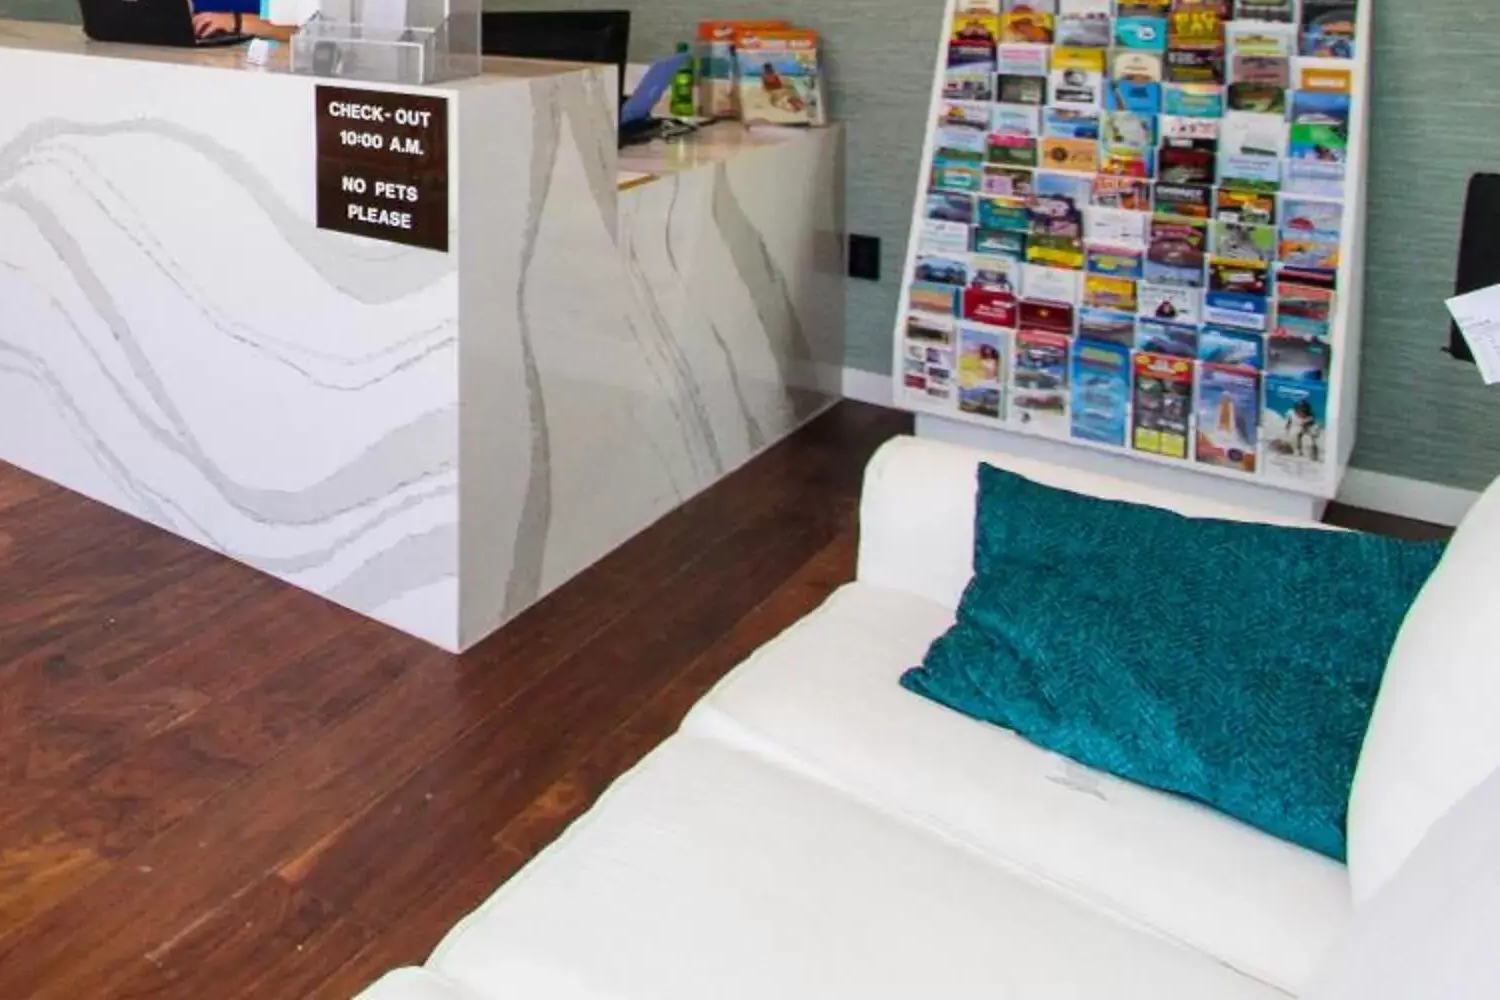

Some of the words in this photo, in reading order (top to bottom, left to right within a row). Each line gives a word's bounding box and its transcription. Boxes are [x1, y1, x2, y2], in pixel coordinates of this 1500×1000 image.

[339, 130, 383, 149] 10:00
[389, 137, 424, 155] A.M.
[342, 176, 366, 193] NO
[375, 181, 418, 201] PETS
[348, 204, 411, 228] PLEASE
